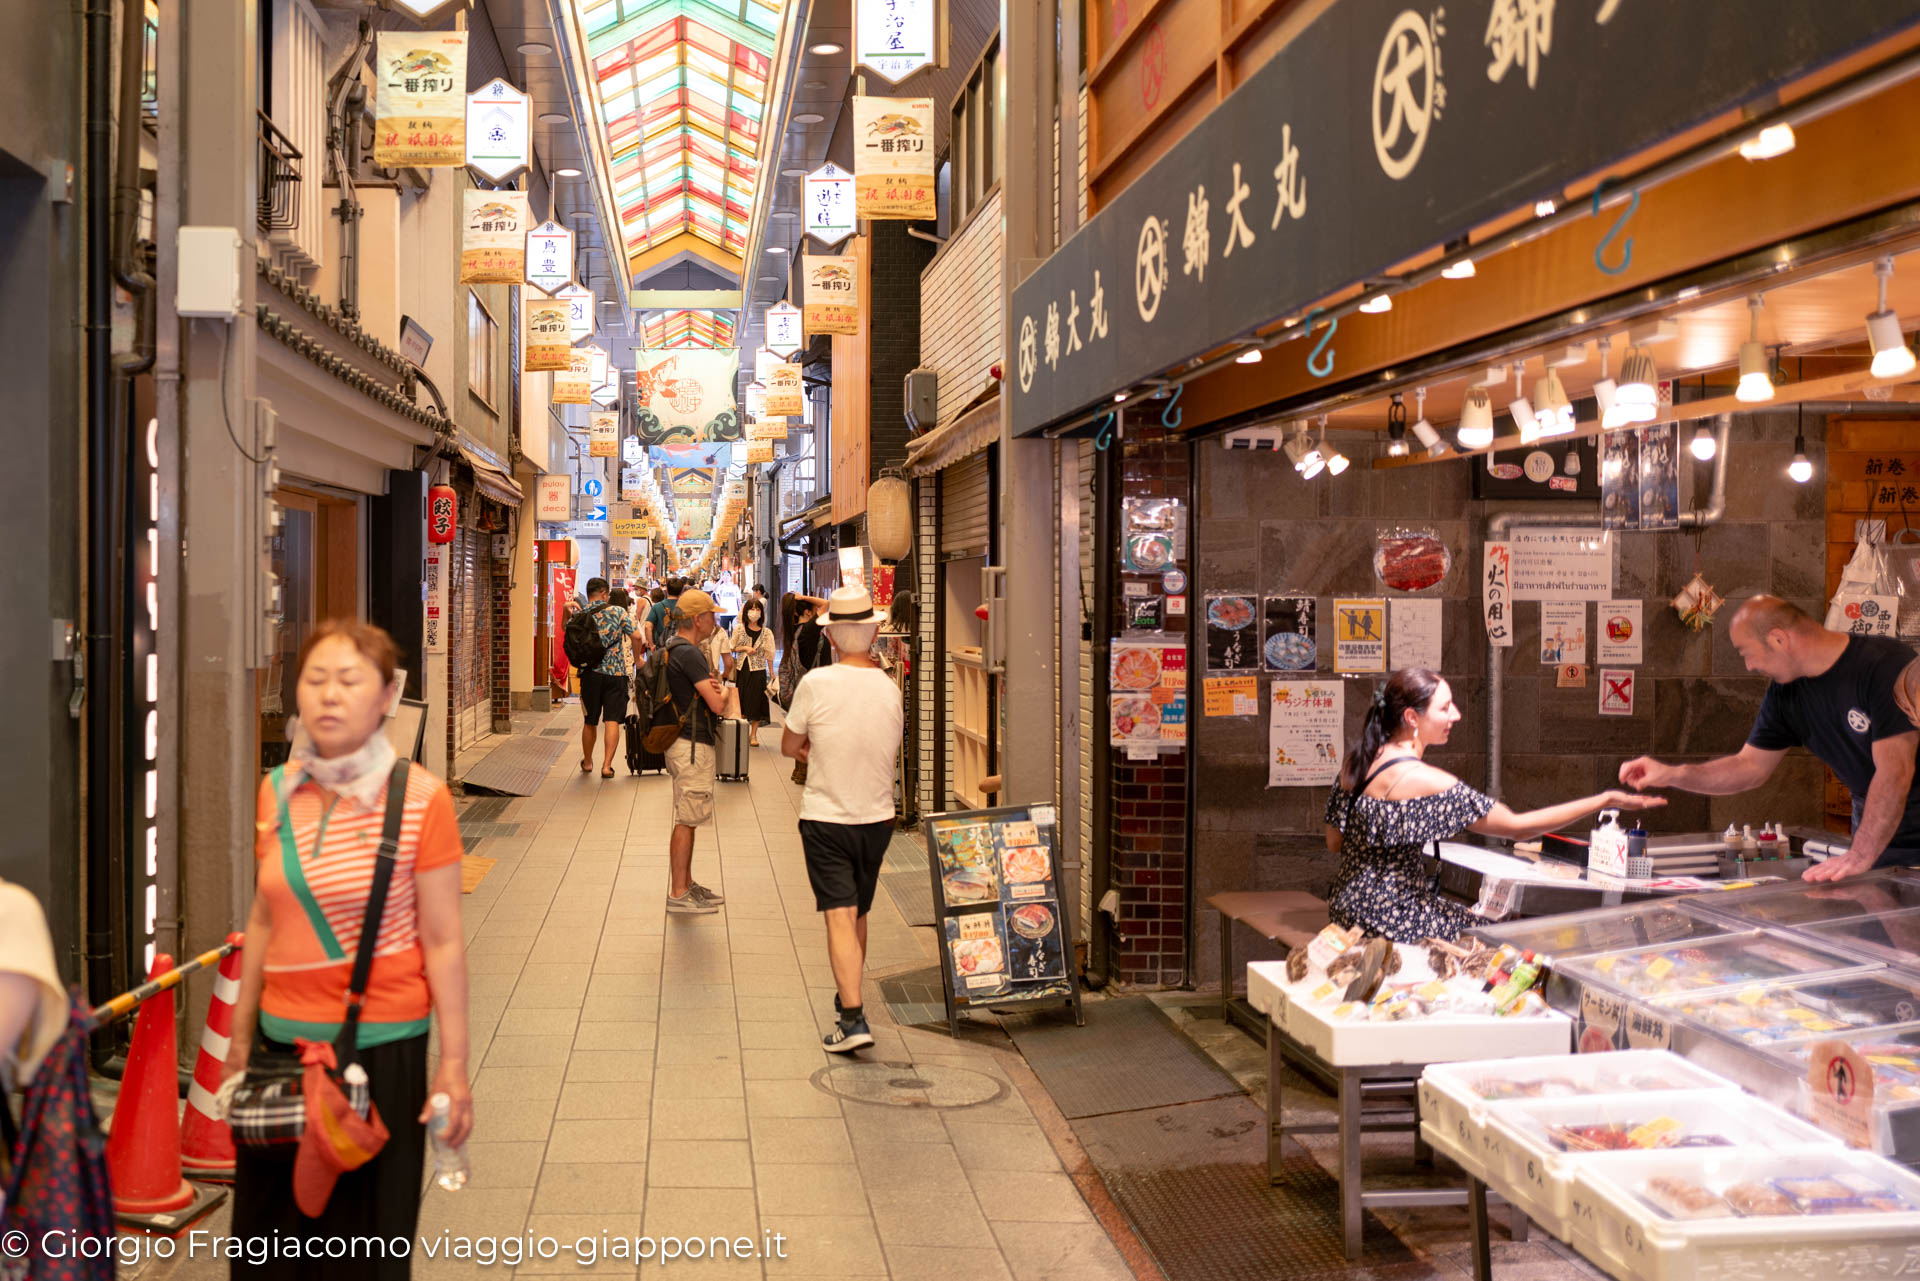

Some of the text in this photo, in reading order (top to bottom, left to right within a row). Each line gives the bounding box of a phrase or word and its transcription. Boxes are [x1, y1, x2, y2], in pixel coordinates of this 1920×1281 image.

[388, 78, 453, 93] 一番搾り
[866, 139, 924, 153] 一番搾り
[470, 221, 517, 232] 一番搾り
[811, 280, 851, 291] 一番搾り
[530, 324, 566, 333] 一番搾り
[1865, 458, 1907, 476] 新巻
[542, 480, 565, 489] pulau
[1878, 486, 1920, 505] 新巻
[542, 504, 567, 512] deco
[434, 498, 452, 534] 餃子
[1488, 564, 1508, 639] 火の用心
[1285, 697, 1333, 708] ラジオ体操
[1584, 992, 1620, 1021] サーモン丼
[1631, 1012, 1663, 1043] 海鮮丼
